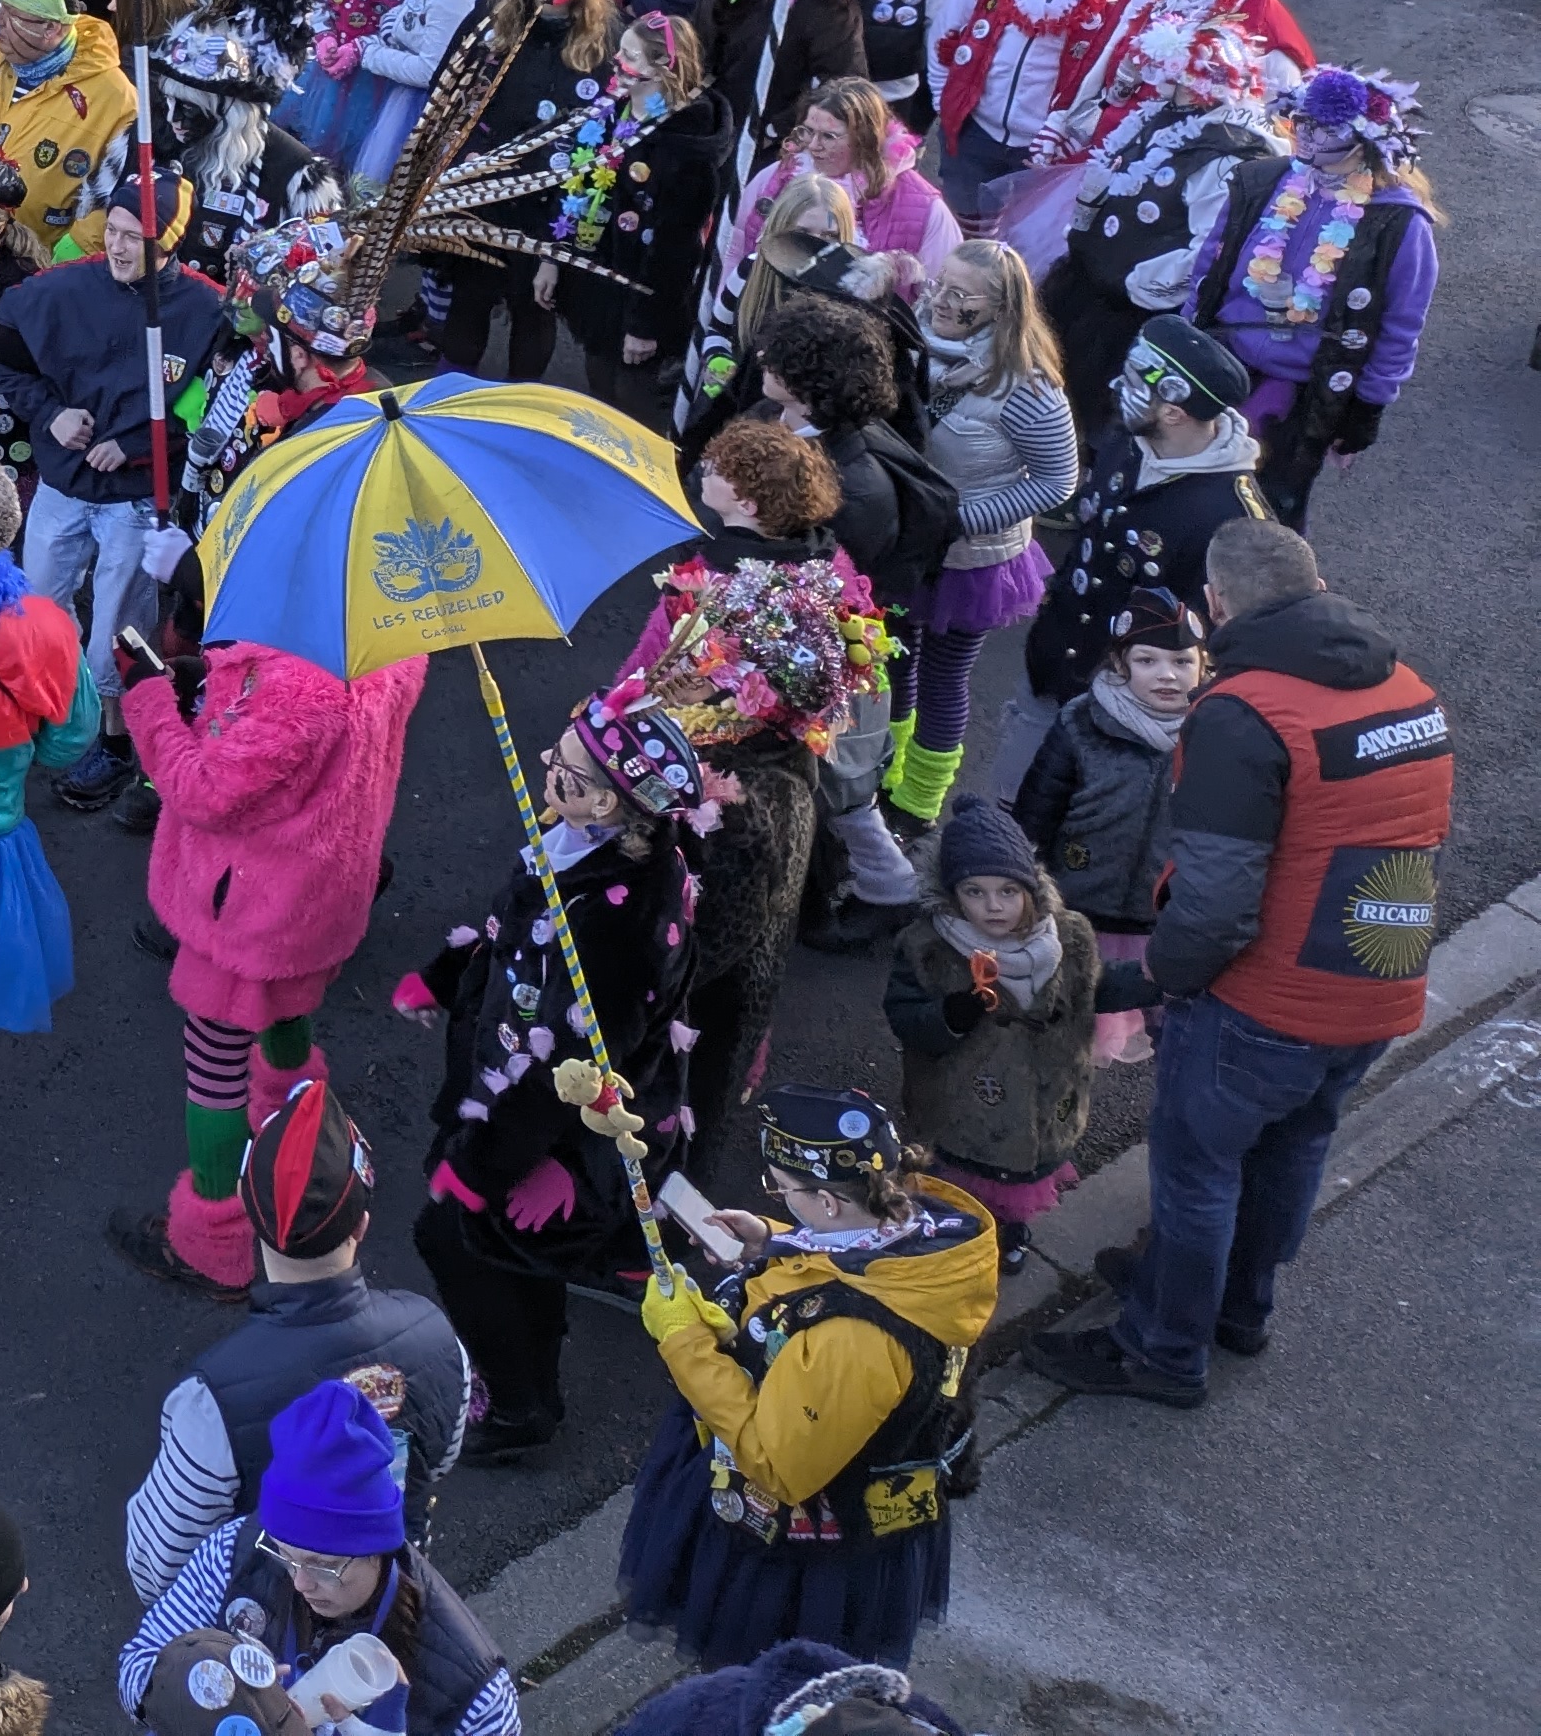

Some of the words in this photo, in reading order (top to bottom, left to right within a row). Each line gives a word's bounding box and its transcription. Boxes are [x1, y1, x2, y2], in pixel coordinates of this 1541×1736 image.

[373, 613, 406, 629] LES
[412, 590, 505, 622] REUZELIED
[1361, 904, 1430, 924] RICARD
